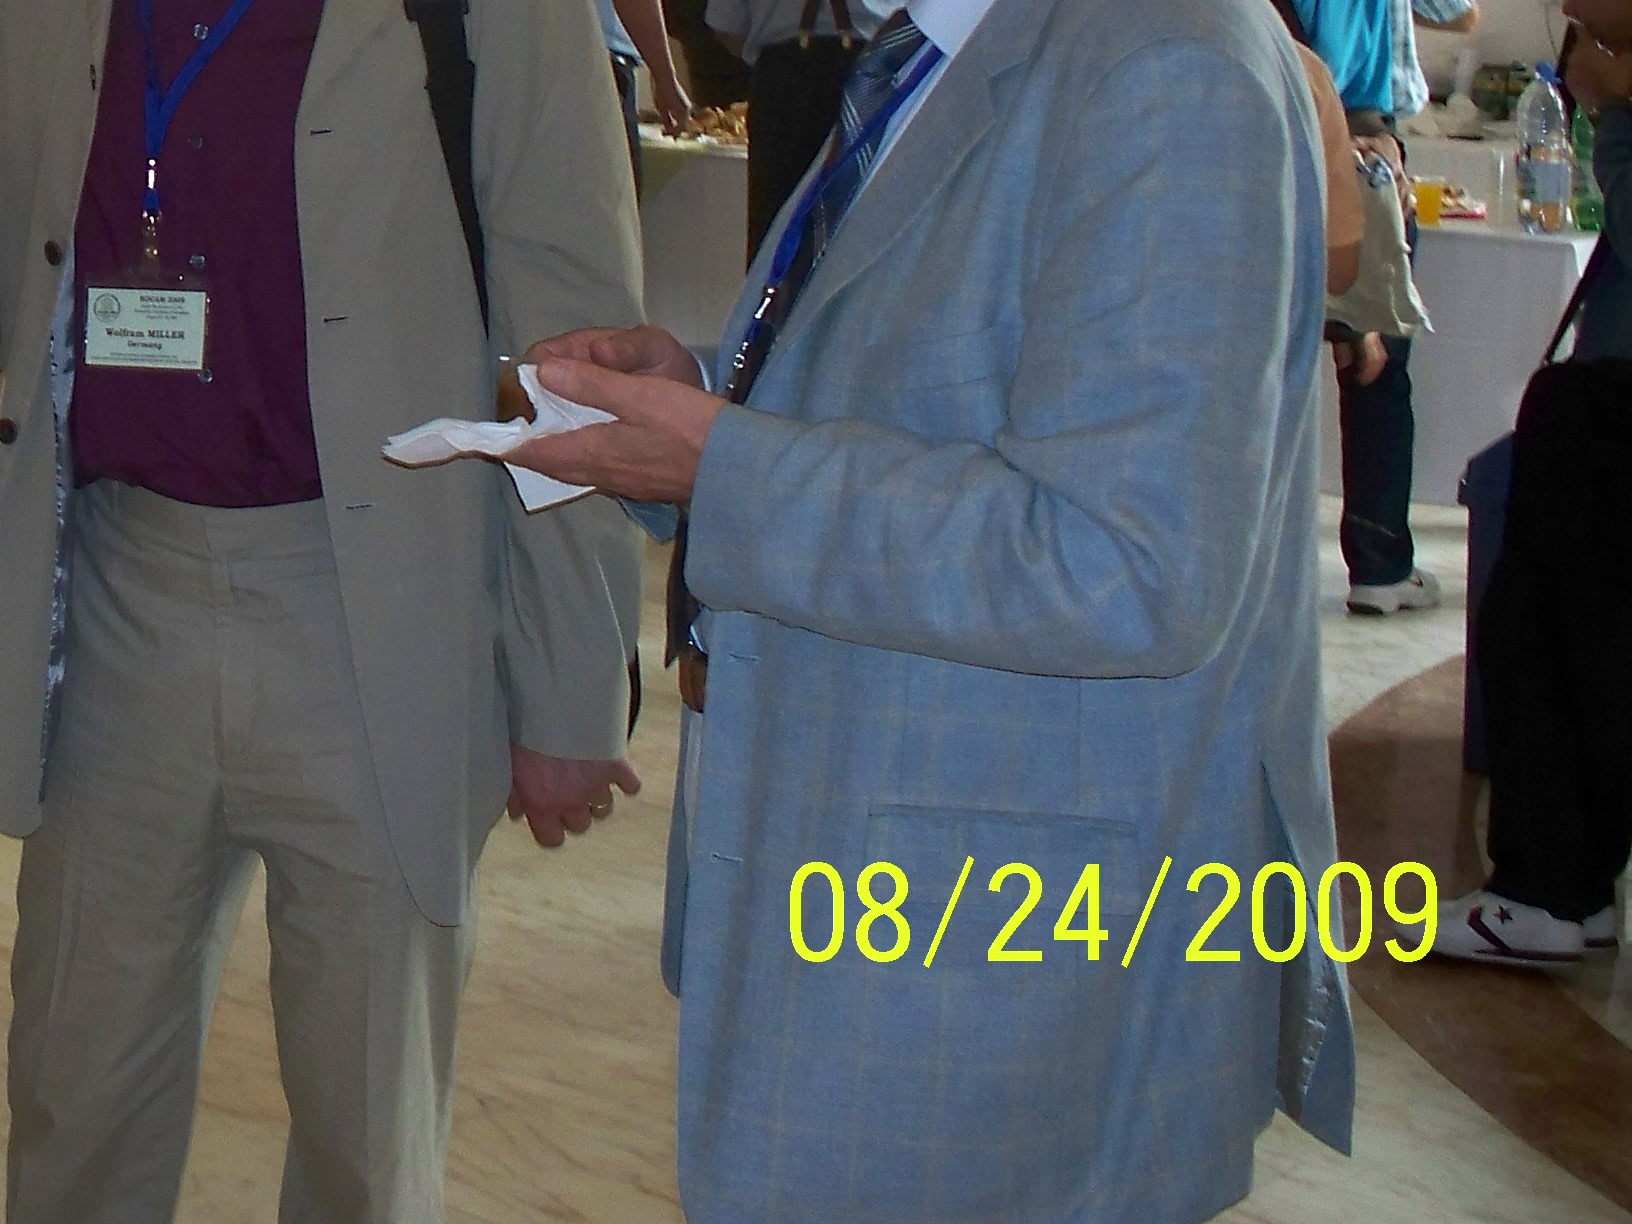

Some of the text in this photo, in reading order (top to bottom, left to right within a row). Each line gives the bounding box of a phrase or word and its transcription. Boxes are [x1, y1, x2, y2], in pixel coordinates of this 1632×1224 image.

[105, 327, 185, 339] Wolfram MILLER
[127, 340, 163, 350] Germany
